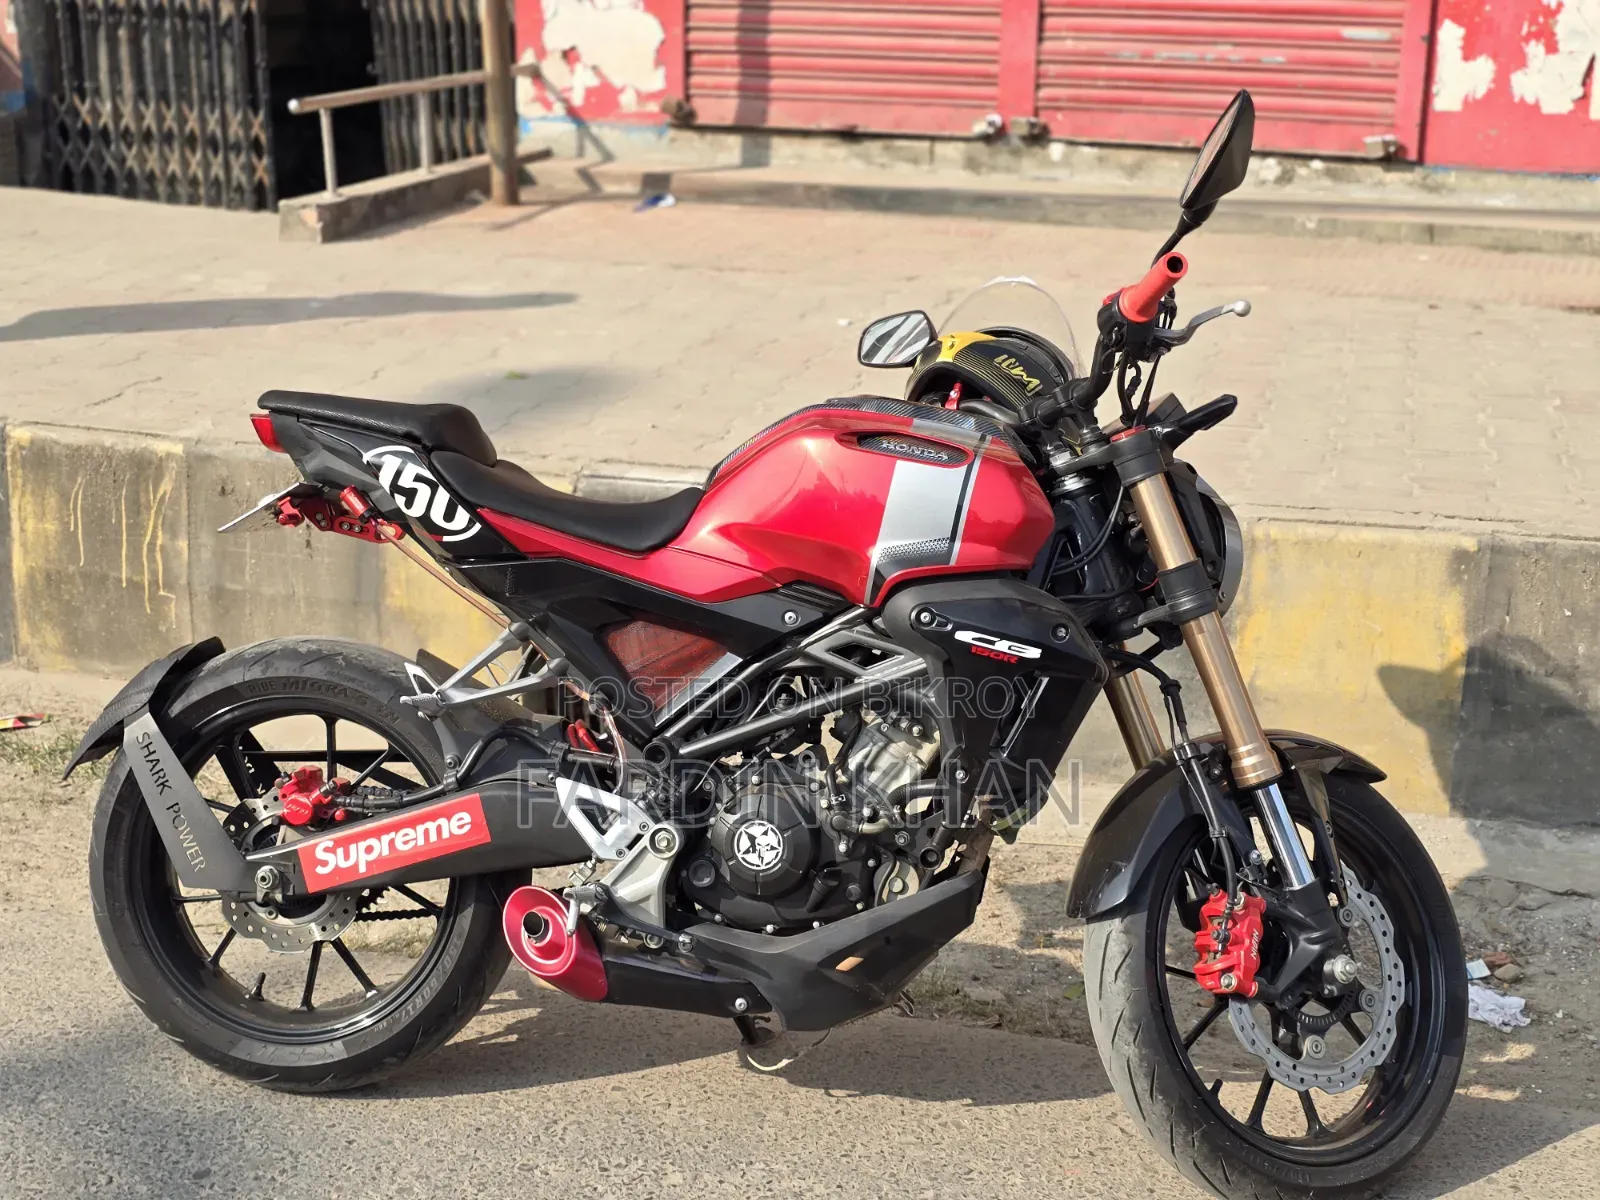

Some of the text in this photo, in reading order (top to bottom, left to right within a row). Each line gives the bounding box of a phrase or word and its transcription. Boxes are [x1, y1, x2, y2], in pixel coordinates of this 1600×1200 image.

[881, 440, 949, 460] HONDA
[379, 454, 471, 531] 150
[954, 630, 1043, 659] CB
[971, 644, 1018, 664] 150R
[136, 731, 206, 872] SHARK POWER
[315, 811, 472, 875] Supreme
